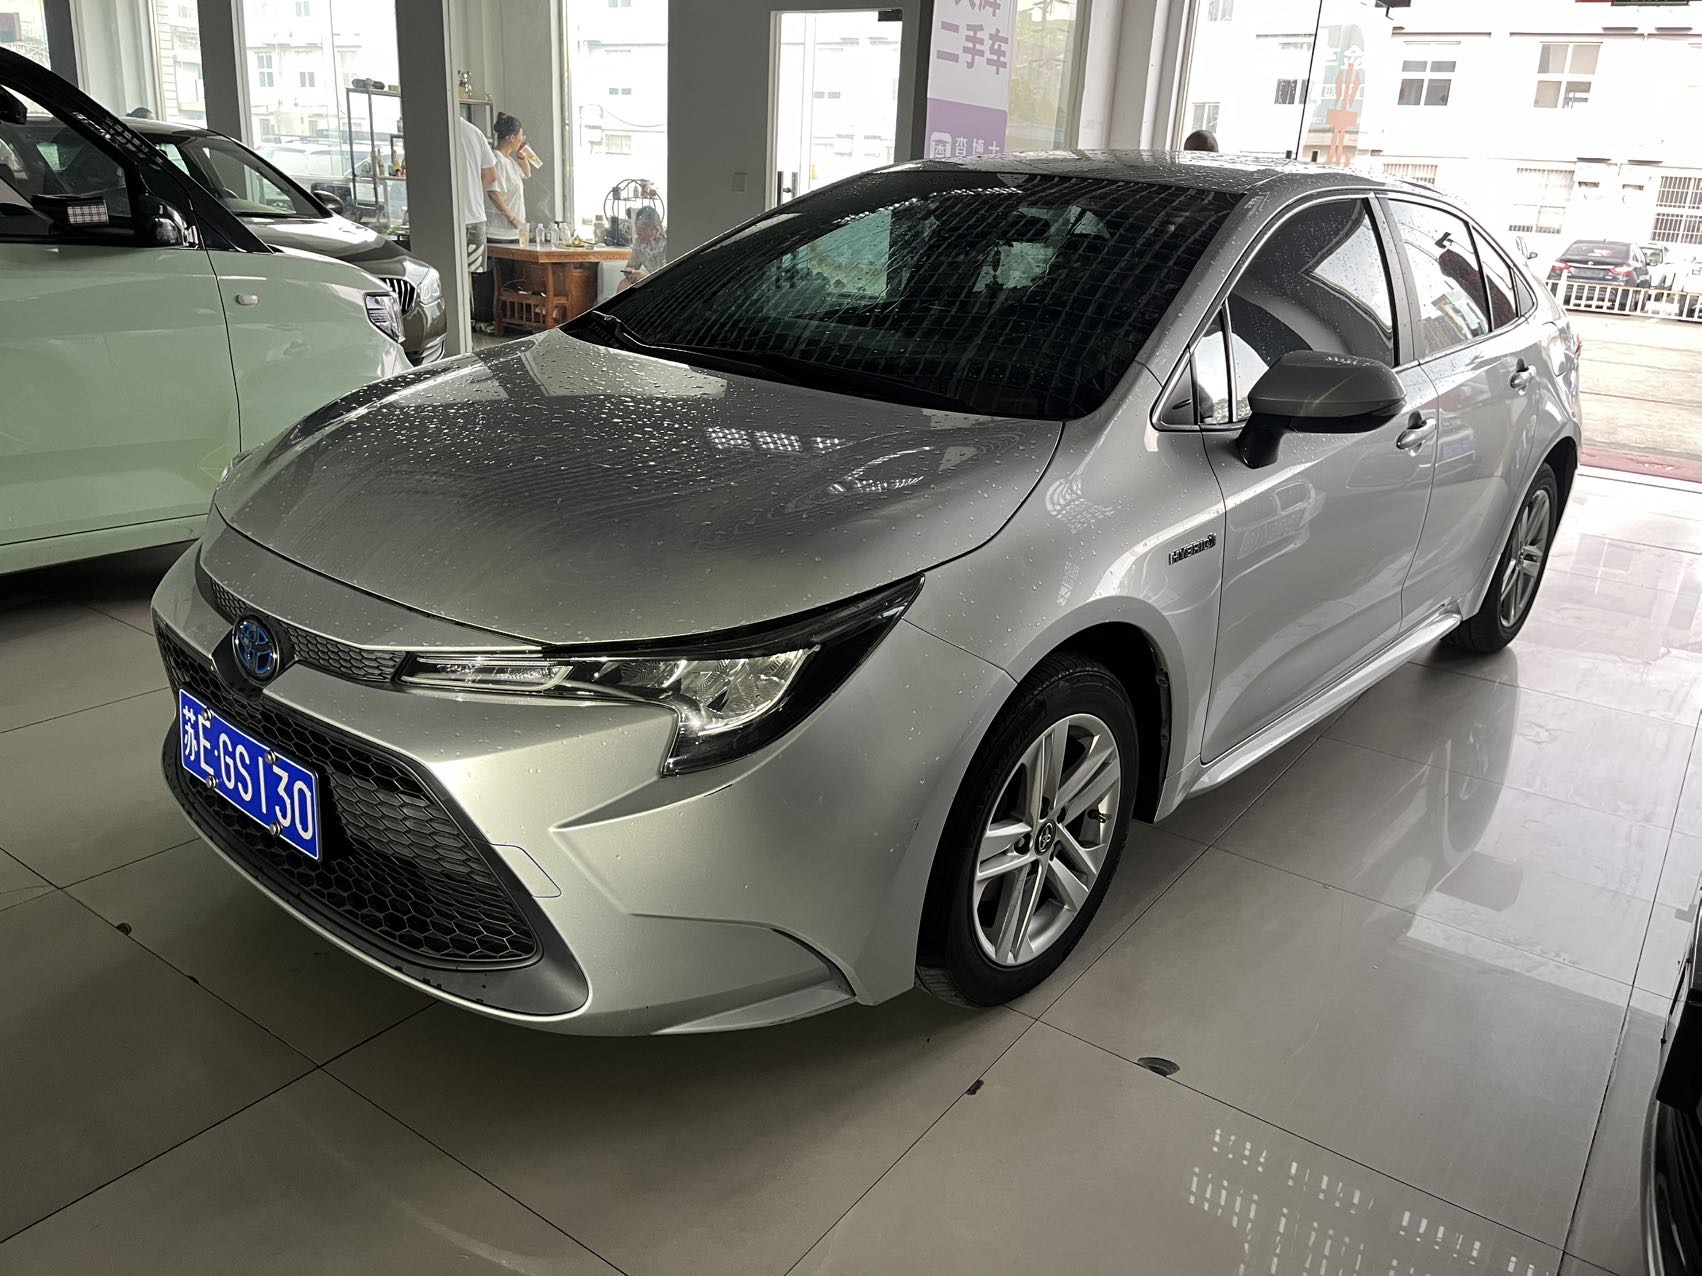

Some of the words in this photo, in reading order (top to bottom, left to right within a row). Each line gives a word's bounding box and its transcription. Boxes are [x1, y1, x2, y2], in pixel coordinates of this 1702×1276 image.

[936, 20, 1009, 75] 二手车
[1168, 533, 1216, 566] HYBRID
